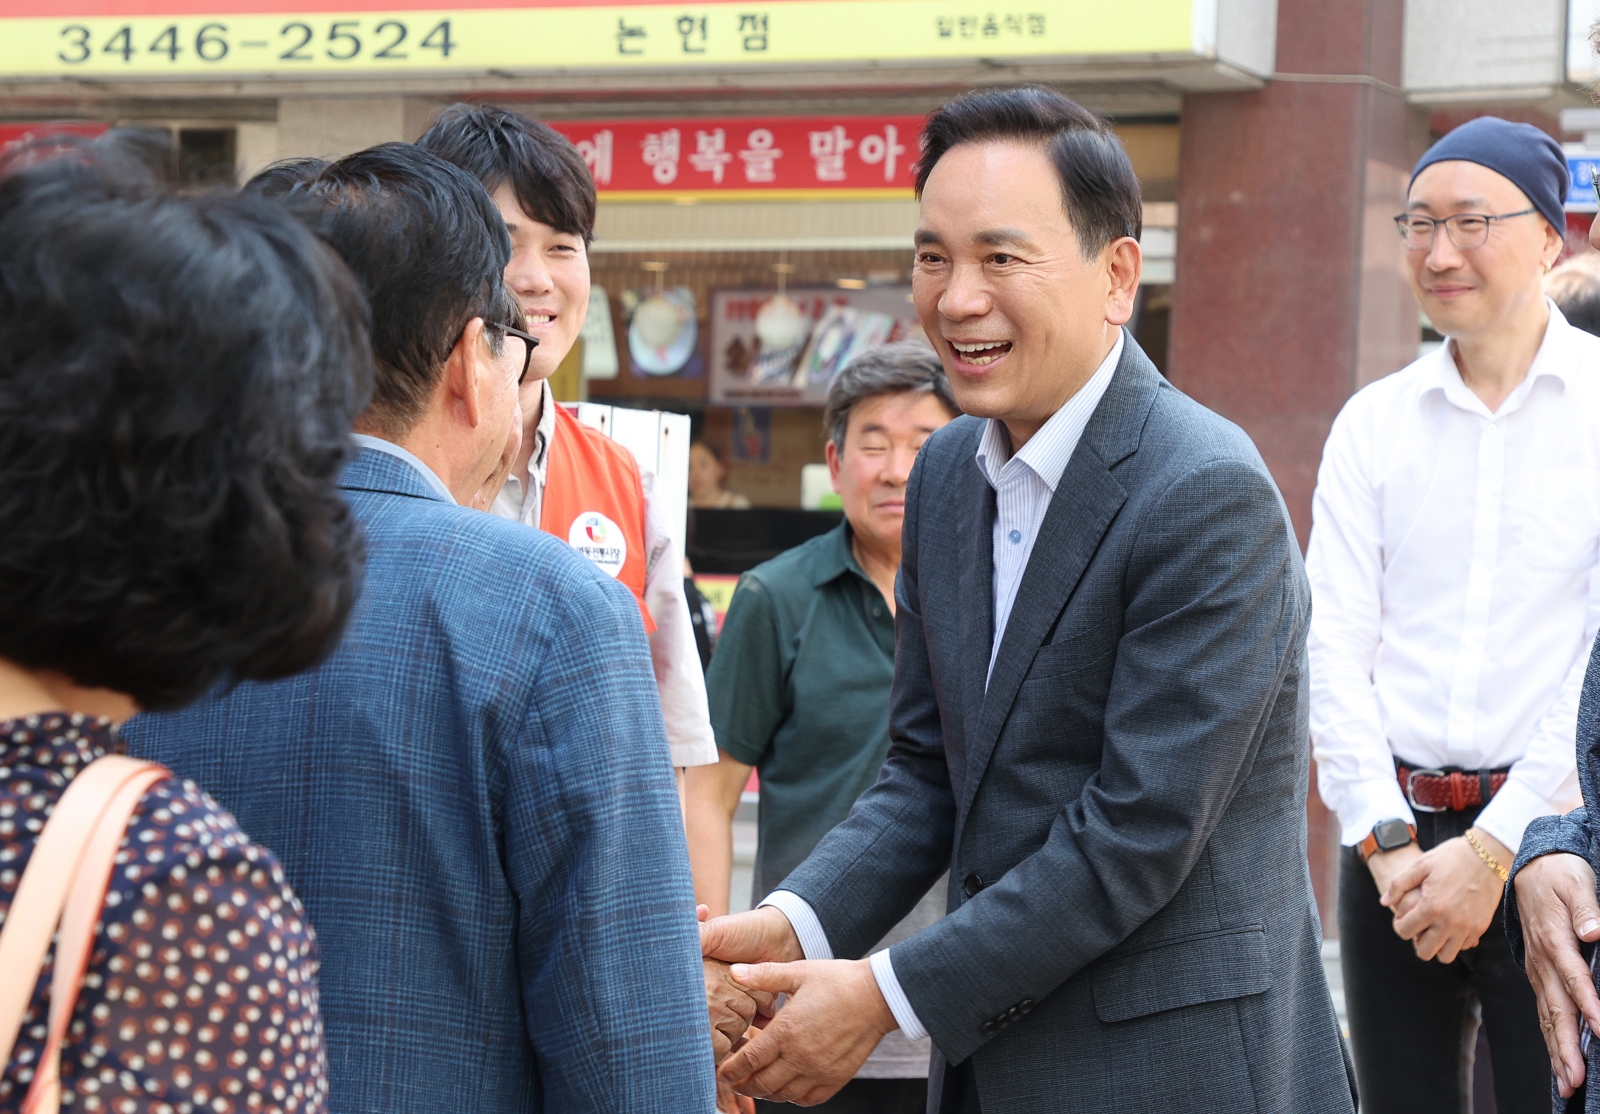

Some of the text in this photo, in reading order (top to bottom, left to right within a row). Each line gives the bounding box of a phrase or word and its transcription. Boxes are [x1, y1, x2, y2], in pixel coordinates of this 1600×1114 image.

[57, 19, 458, 64] 3446-2524
[640, 127, 783, 185] 행복을
[808, 124, 917, 183] 말아
